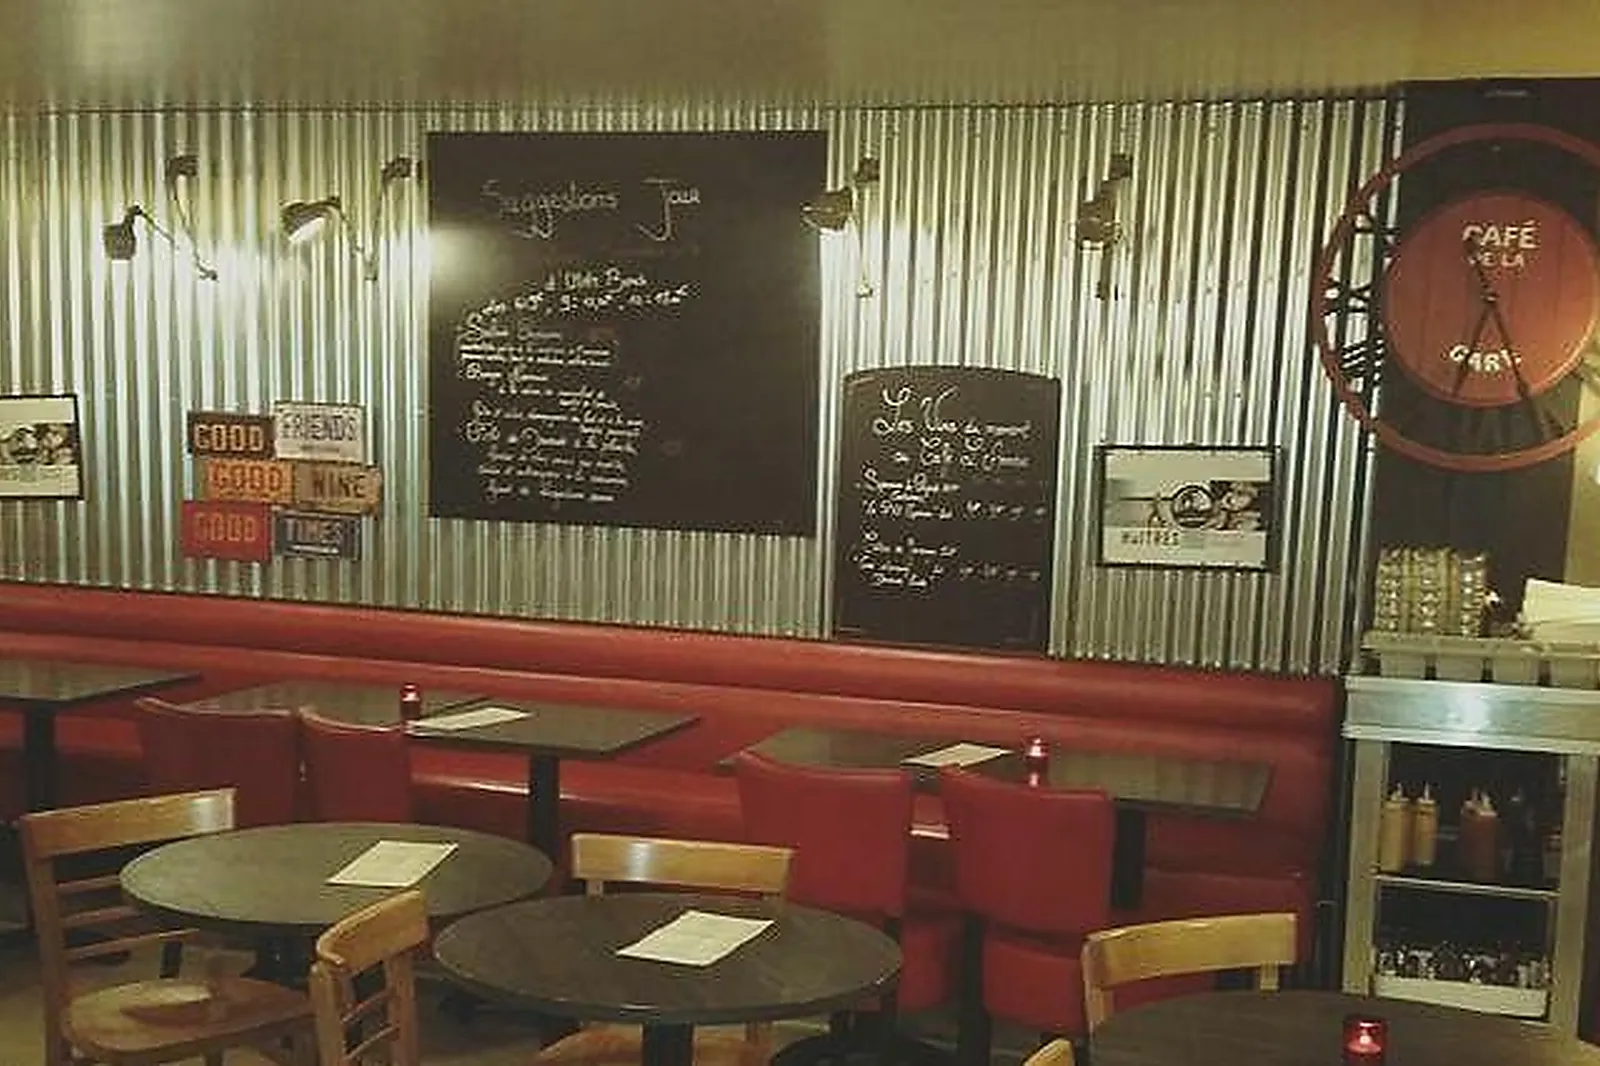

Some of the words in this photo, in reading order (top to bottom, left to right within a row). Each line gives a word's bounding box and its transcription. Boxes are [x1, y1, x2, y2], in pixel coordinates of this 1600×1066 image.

[1462, 219, 1537, 249] CAFÉ
[1501, 253, 1525, 268] LA
[194, 423, 264, 451] GOOD
[282, 411, 358, 441] FRIENDS
[213, 463, 284, 491] GOOD
[312, 470, 366, 498] WINE
[192, 512, 258, 542] GOOD
